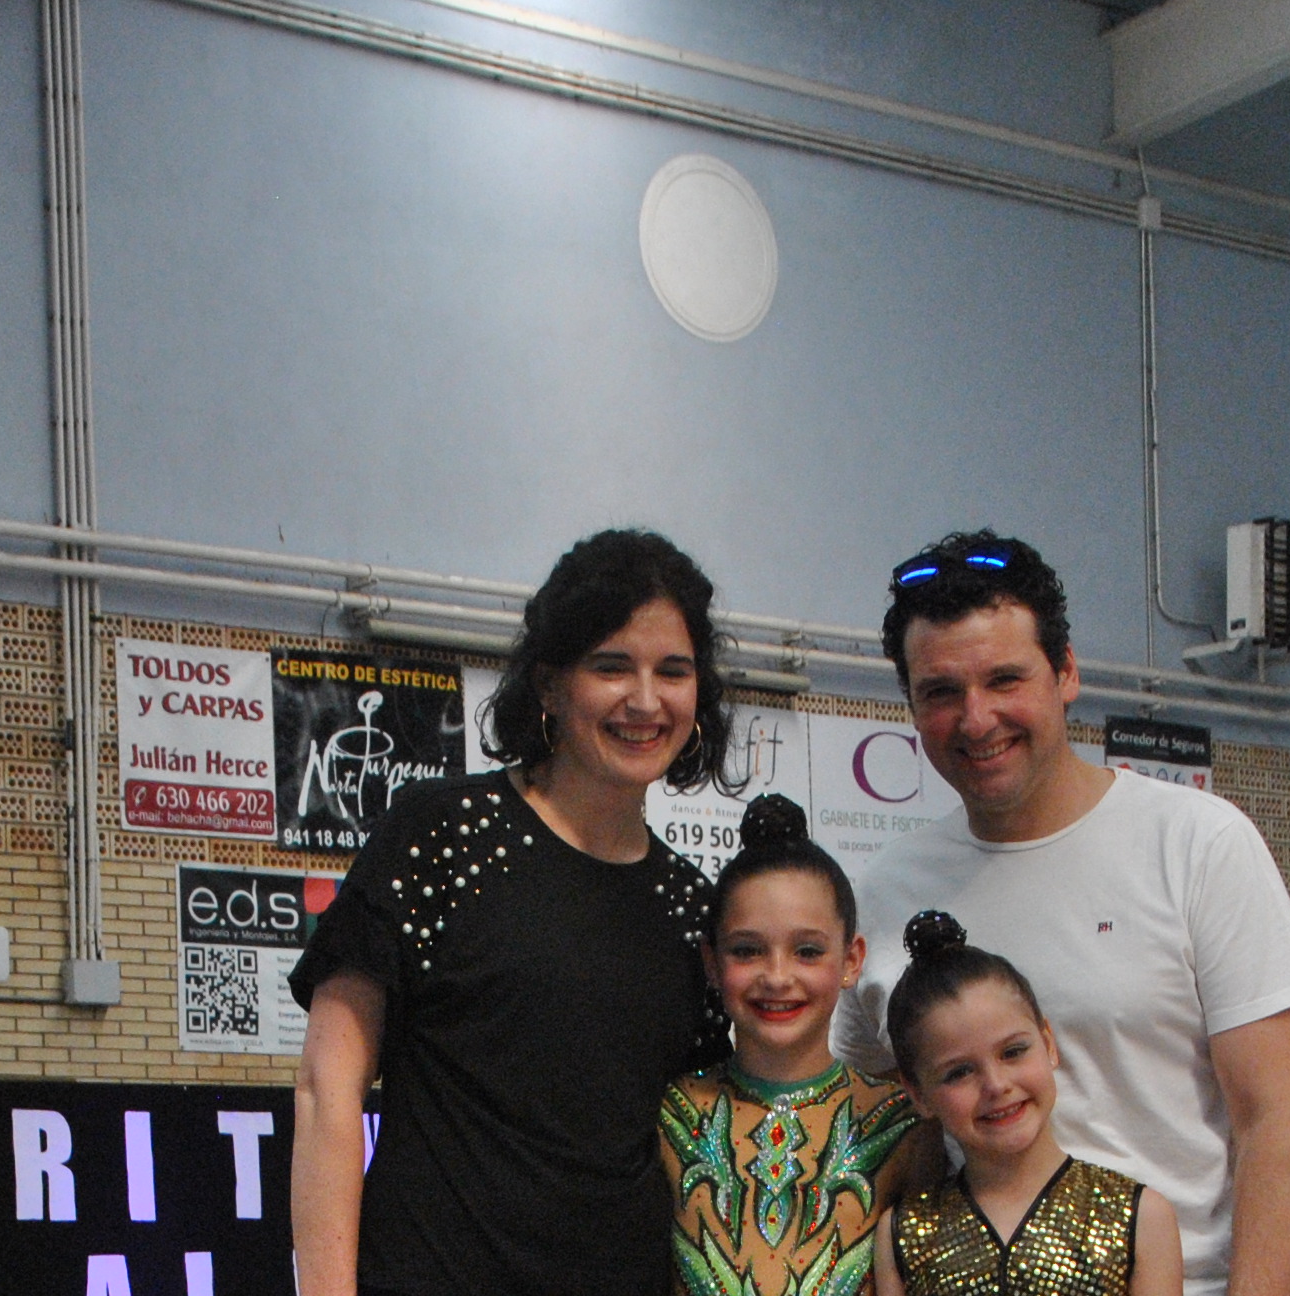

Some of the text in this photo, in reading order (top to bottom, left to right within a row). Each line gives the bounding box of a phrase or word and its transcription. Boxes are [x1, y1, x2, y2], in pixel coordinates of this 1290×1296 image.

[127, 654, 231, 686] TOLDOS
[277, 659, 457, 692] CENTRO DE ESTÉTICA
[138, 692, 264, 721] y CARPAS
[1112, 730, 1156, 746] Corredor
[1159, 735, 1169, 747] de
[1172, 737, 1206, 754] Seguros
[130, 743, 269, 778] Julián Herce
[852, 731, 918, 803] C
[156, 785, 268, 816] 630 466 202
[671, 803, 701, 815] dance
[665, 822, 703, 846] 619
[819, 809, 869, 829] GABINETE
[873, 814, 887, 830] DE
[284, 828, 309, 846] 941
[315, 830, 332, 846] 18
[337, 830, 354, 847] 48
[188, 879, 300, 930] e.d.s
